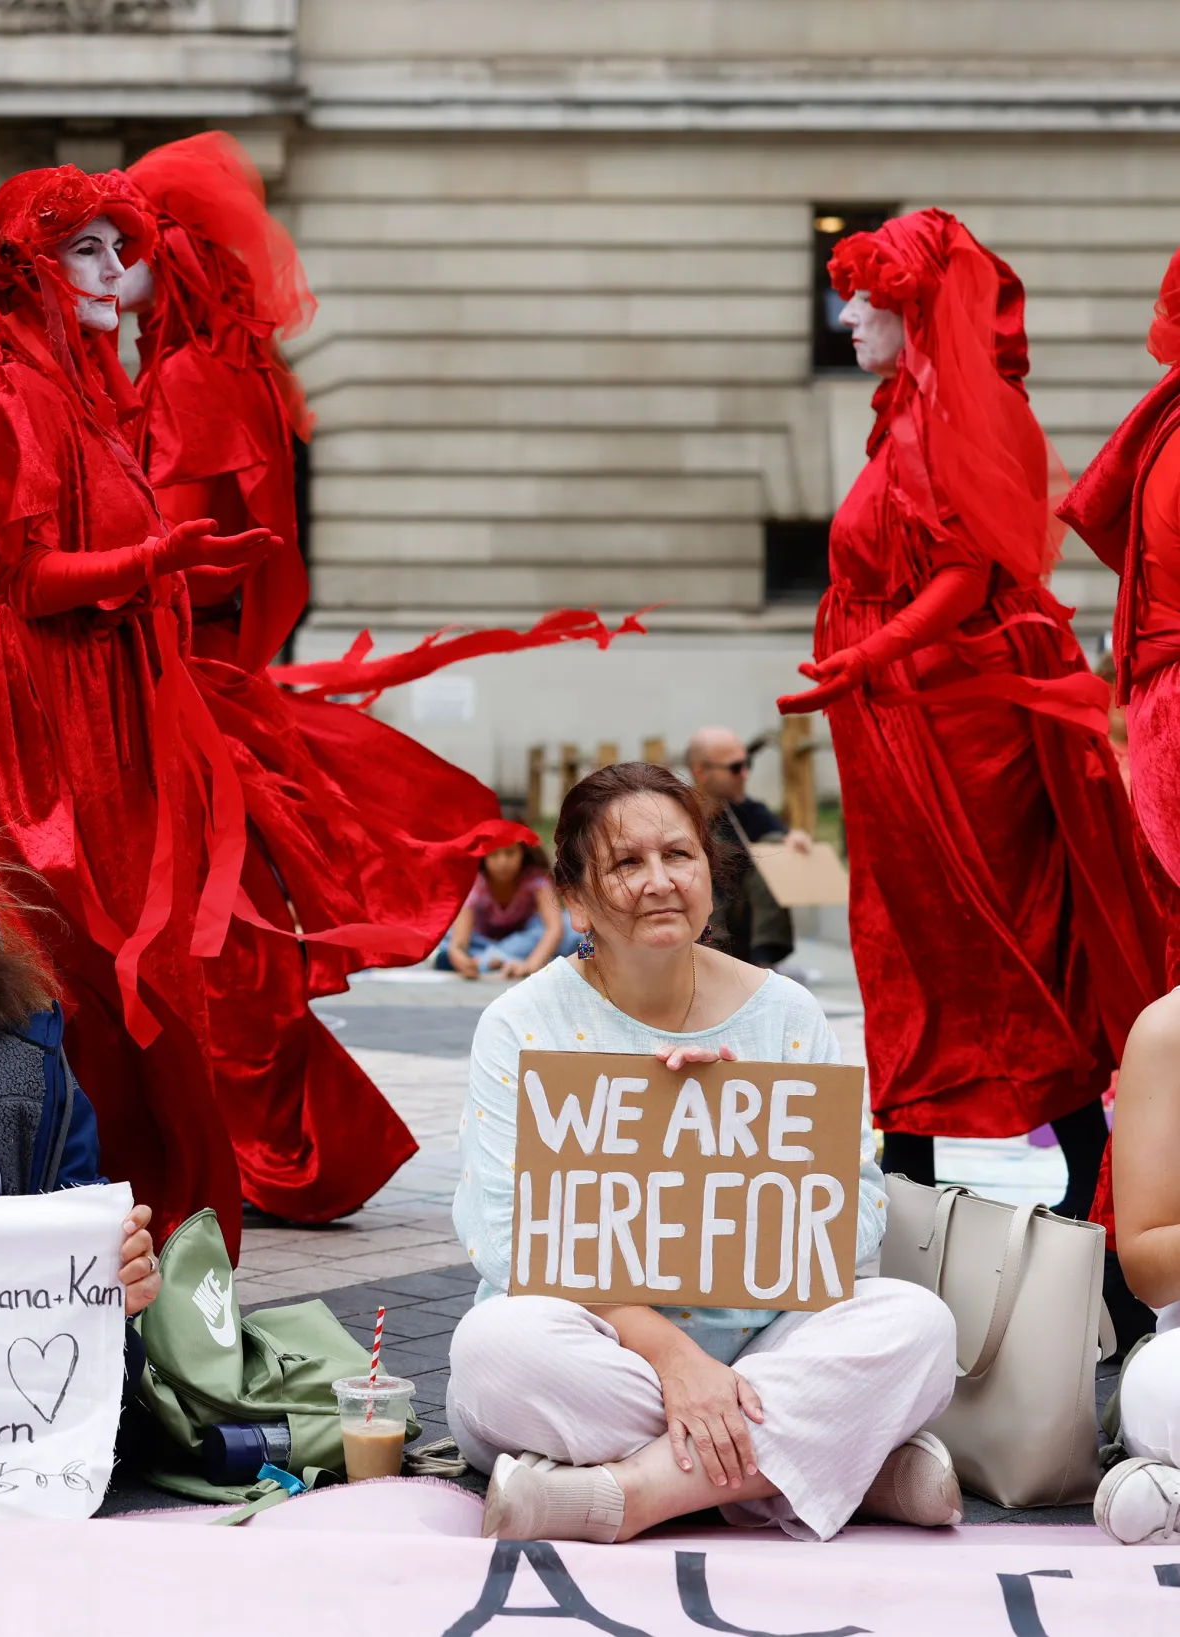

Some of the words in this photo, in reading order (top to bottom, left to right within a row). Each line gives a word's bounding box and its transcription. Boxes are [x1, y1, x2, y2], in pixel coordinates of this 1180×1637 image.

[524, 1069, 649, 1154] WE
[663, 1077, 817, 1161] ARE
[517, 1170, 685, 1290] HERE
[700, 1172, 845, 1301] FOR
[191, 1267, 229, 1325] NIKE
